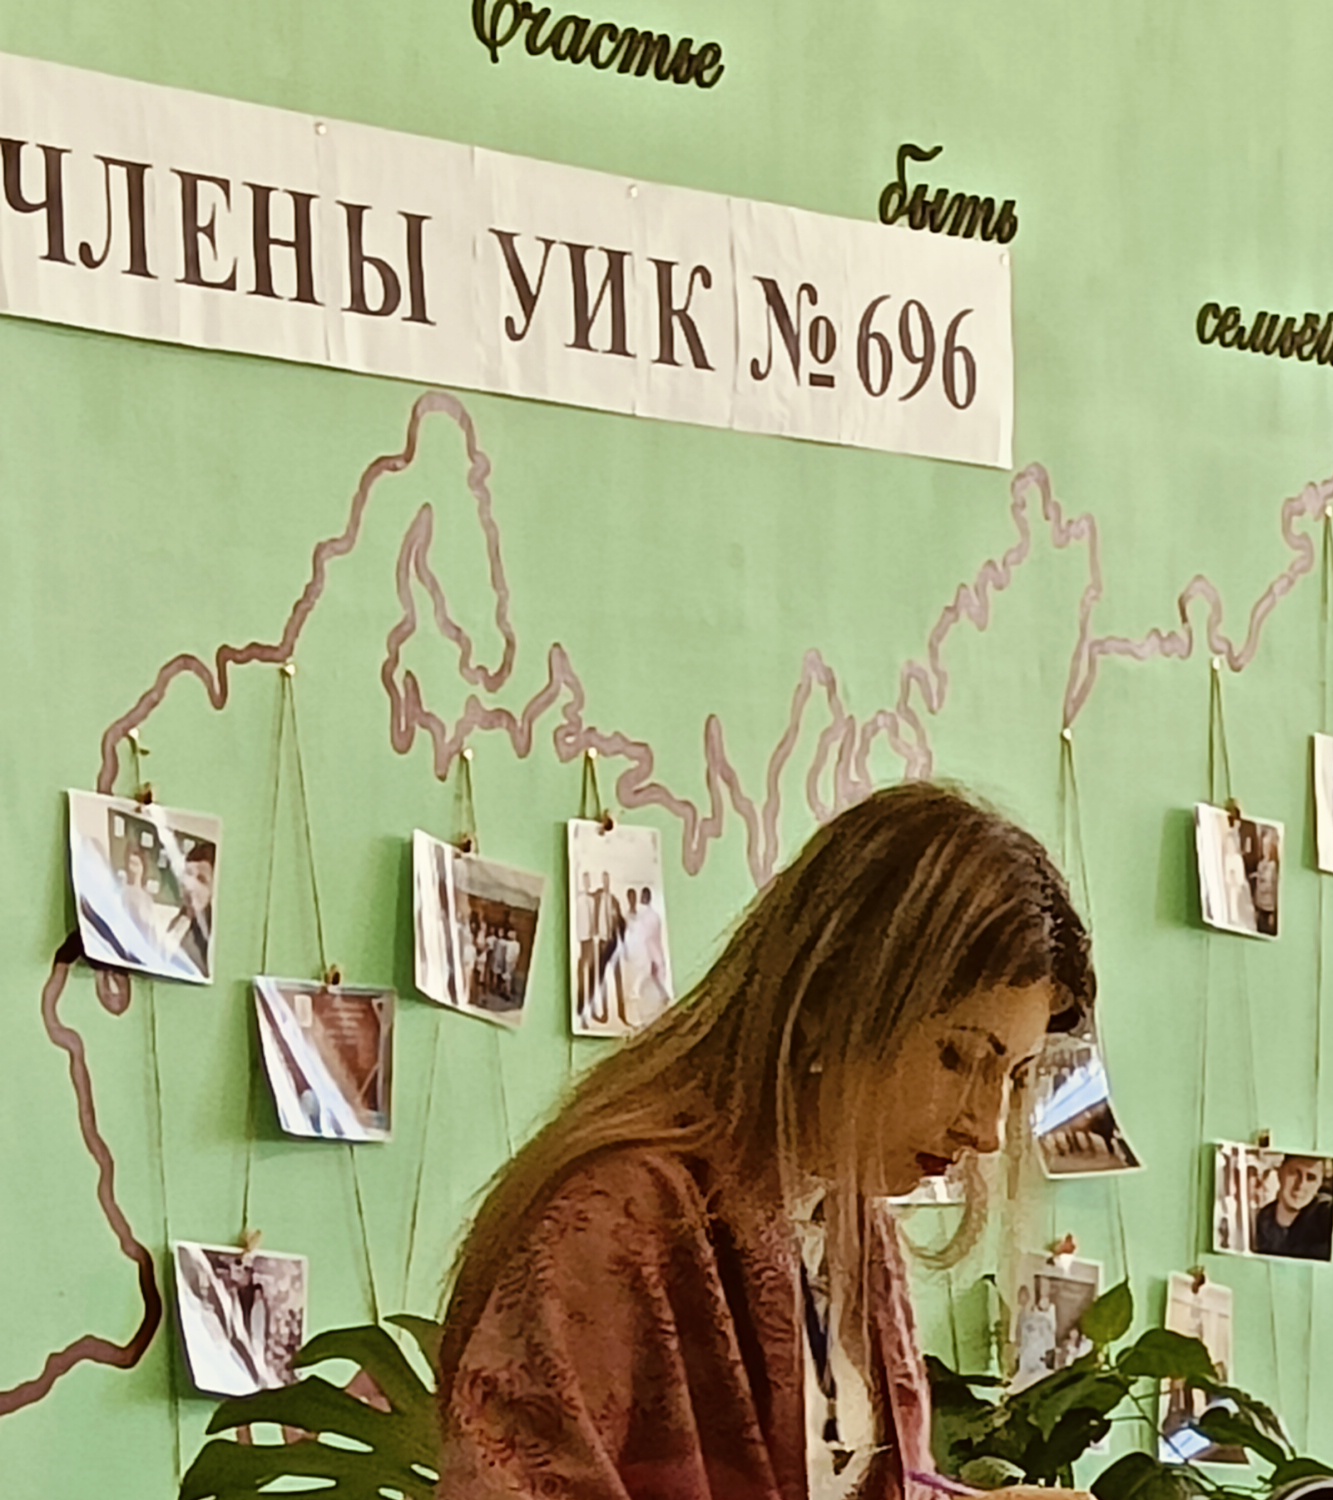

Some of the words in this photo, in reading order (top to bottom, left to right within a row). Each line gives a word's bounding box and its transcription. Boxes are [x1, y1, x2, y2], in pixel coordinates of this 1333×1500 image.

[0, 137, 436, 325] ЧЛЕНЫ
[488, 228, 715, 371] УИК
[856, 294, 978, 409] 696
[879, 143, 1018, 244] быть
